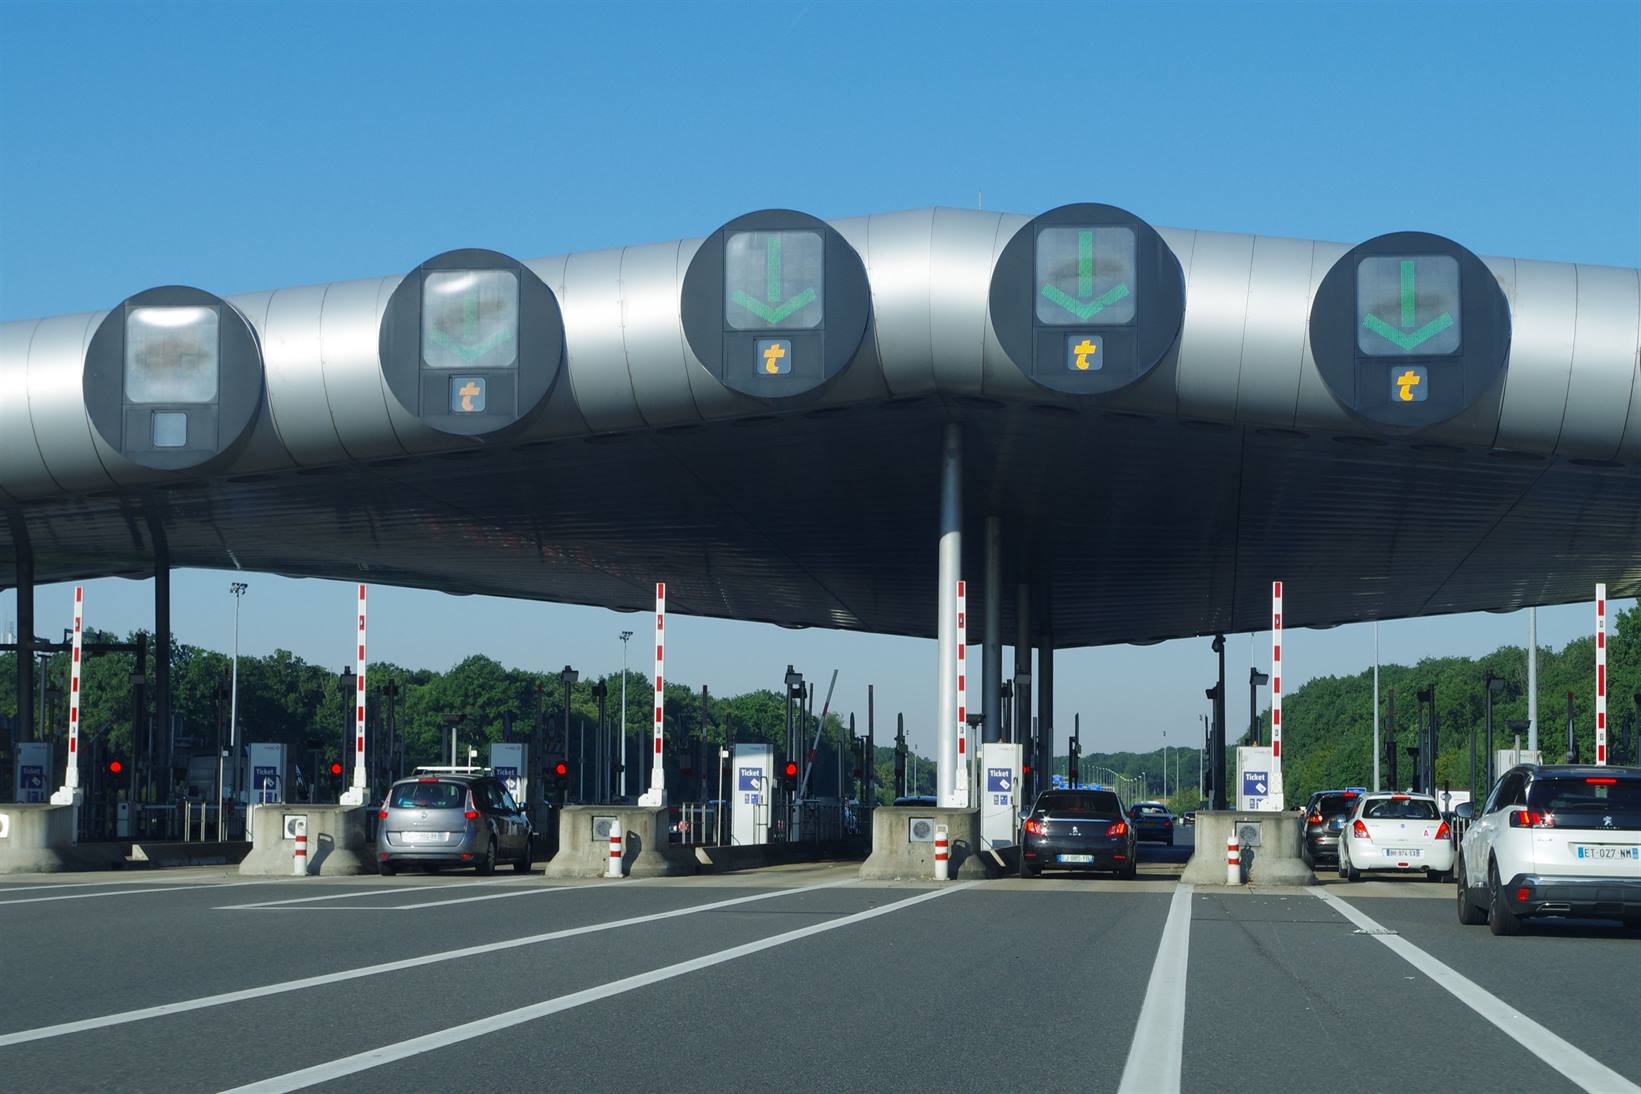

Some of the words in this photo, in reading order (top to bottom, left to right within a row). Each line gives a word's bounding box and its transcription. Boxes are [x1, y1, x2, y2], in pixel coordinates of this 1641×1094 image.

[763, 343, 785, 374] t
[1073, 340, 1096, 369] t
[1397, 371, 1420, 401] t
[459, 383, 480, 411] t
[496, 768, 515, 776] Ticket
[741, 769, 760, 777] Ticket
[990, 769, 1009, 778] Ticket
[1245, 773, 1265, 781] Ticket
